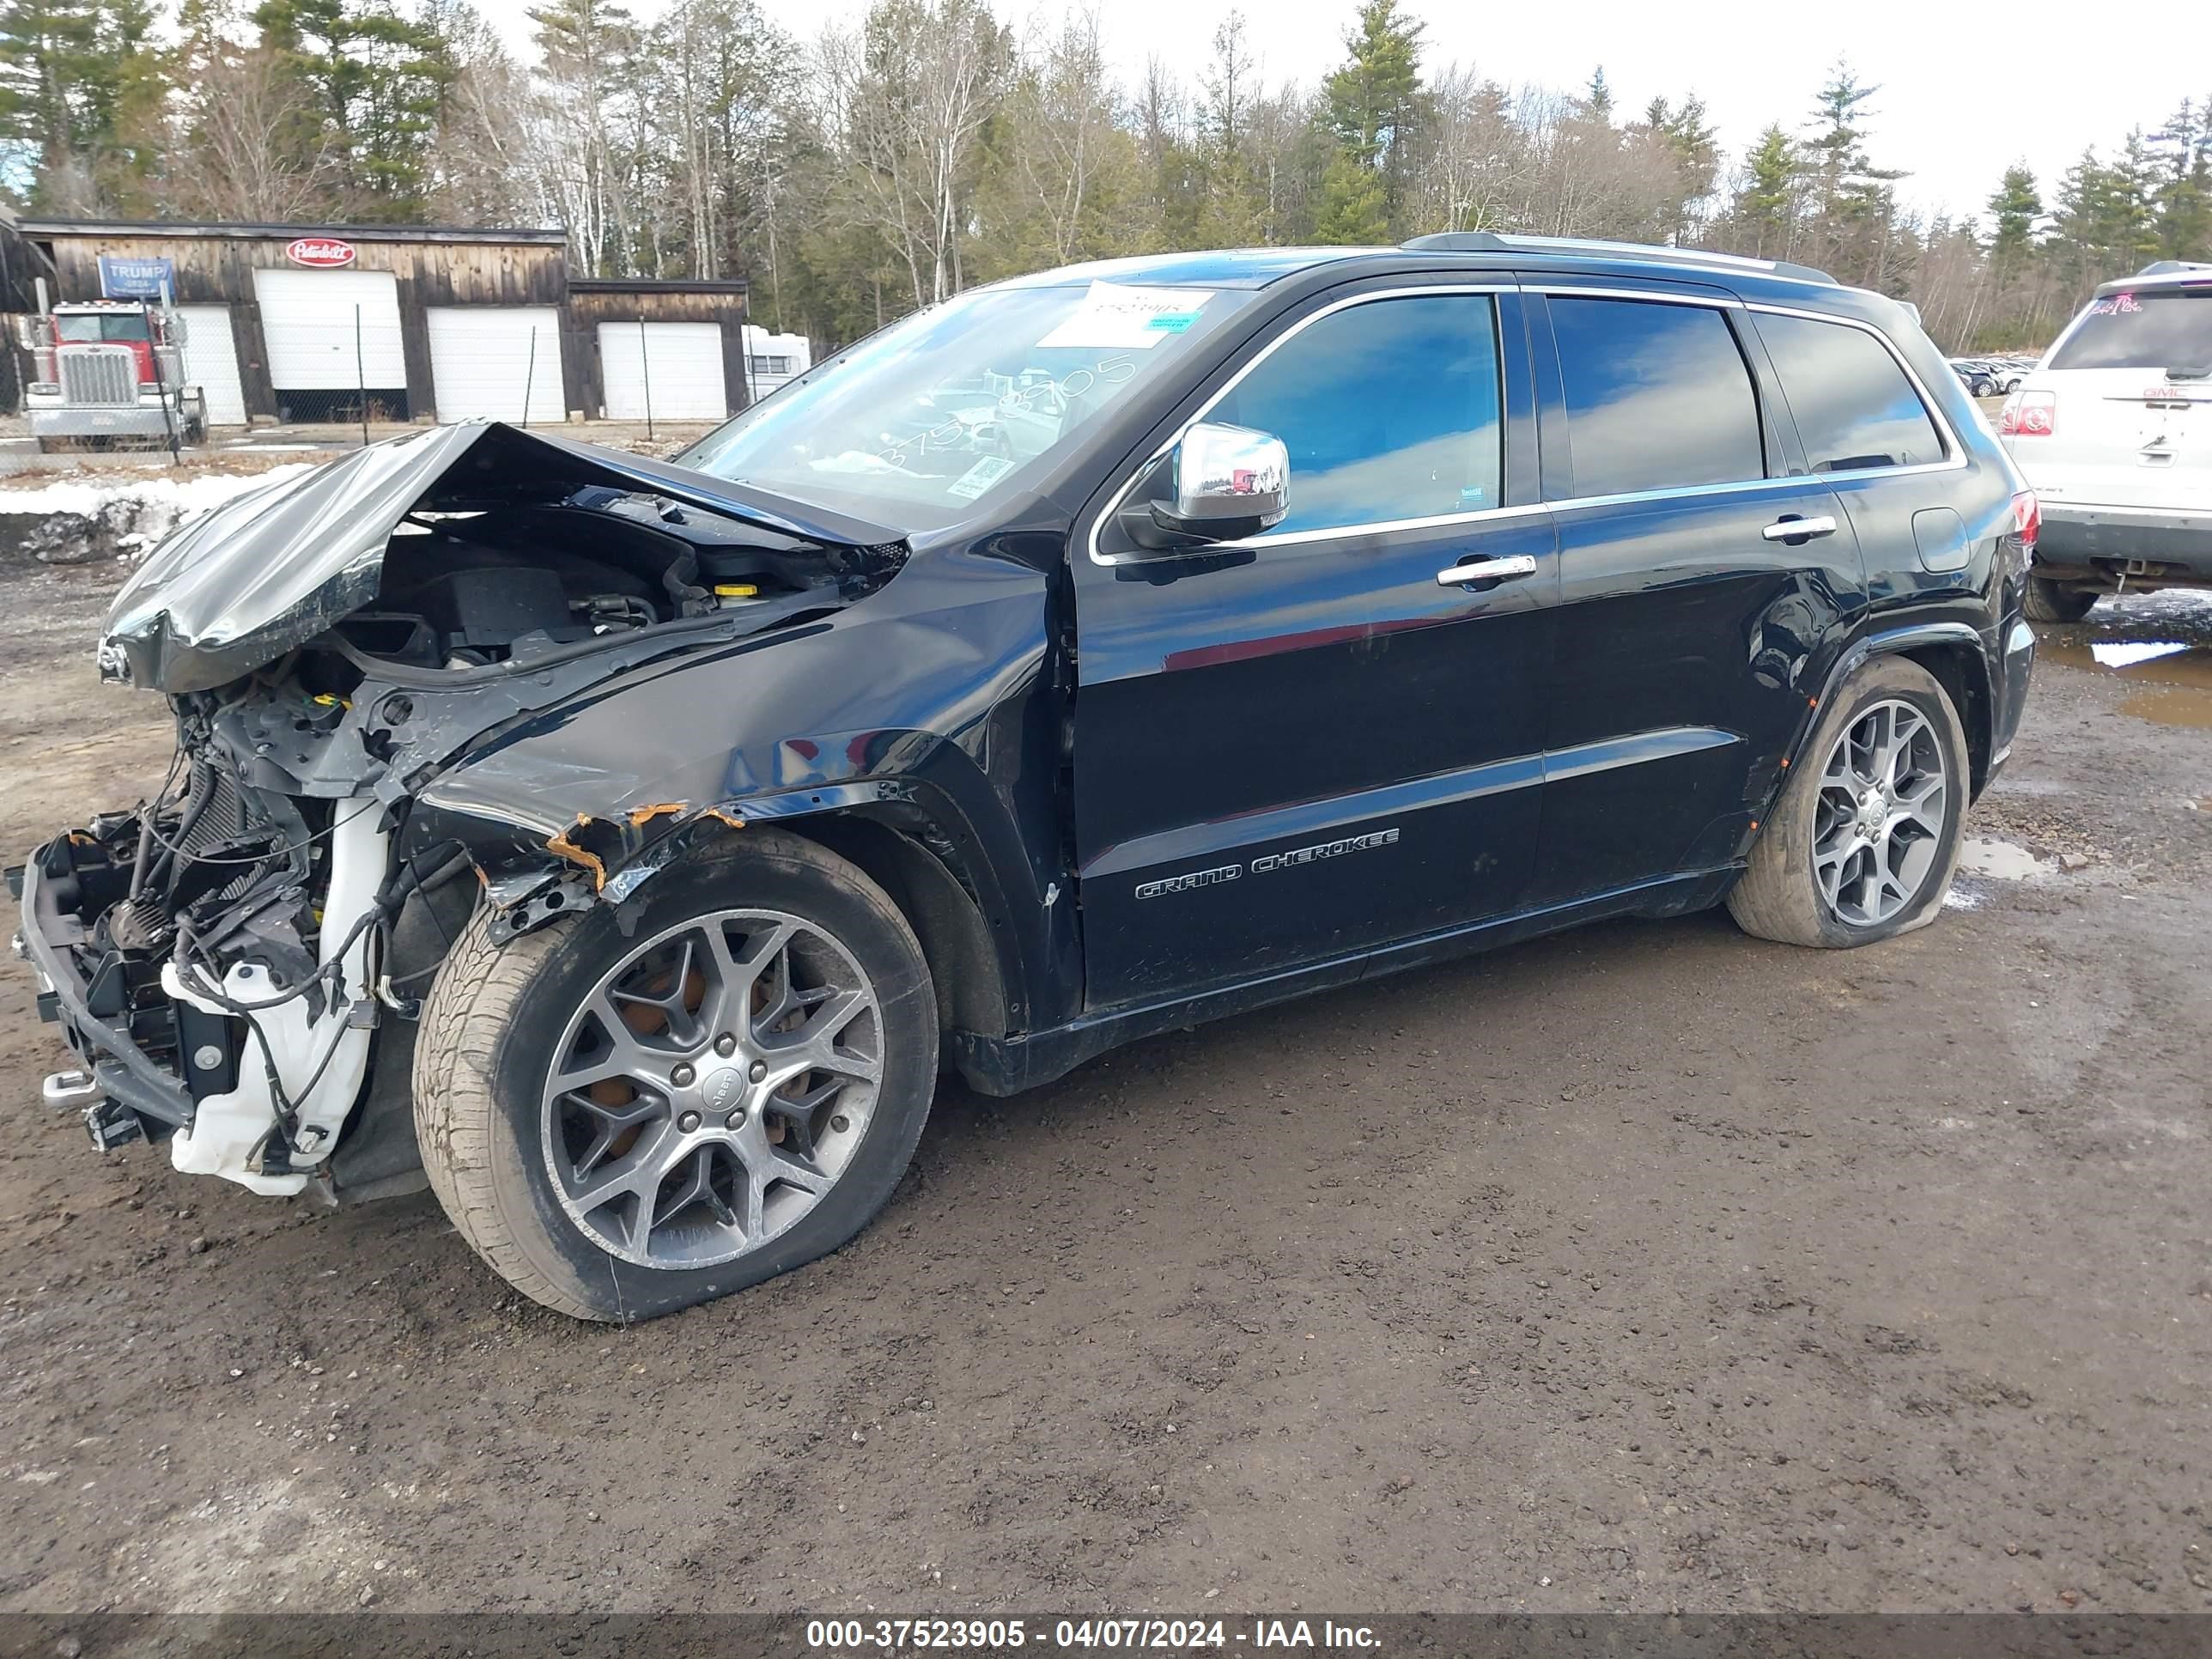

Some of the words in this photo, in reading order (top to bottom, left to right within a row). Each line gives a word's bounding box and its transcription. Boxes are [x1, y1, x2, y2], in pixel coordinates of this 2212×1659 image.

[294, 242, 351, 259] Peterbilt
[109, 265, 163, 278] TRUMP
[2143, 388, 2188, 398] GMC
[1134, 865, 1243, 900] GRAND
[1251, 828, 1400, 873] CHEROKEE
